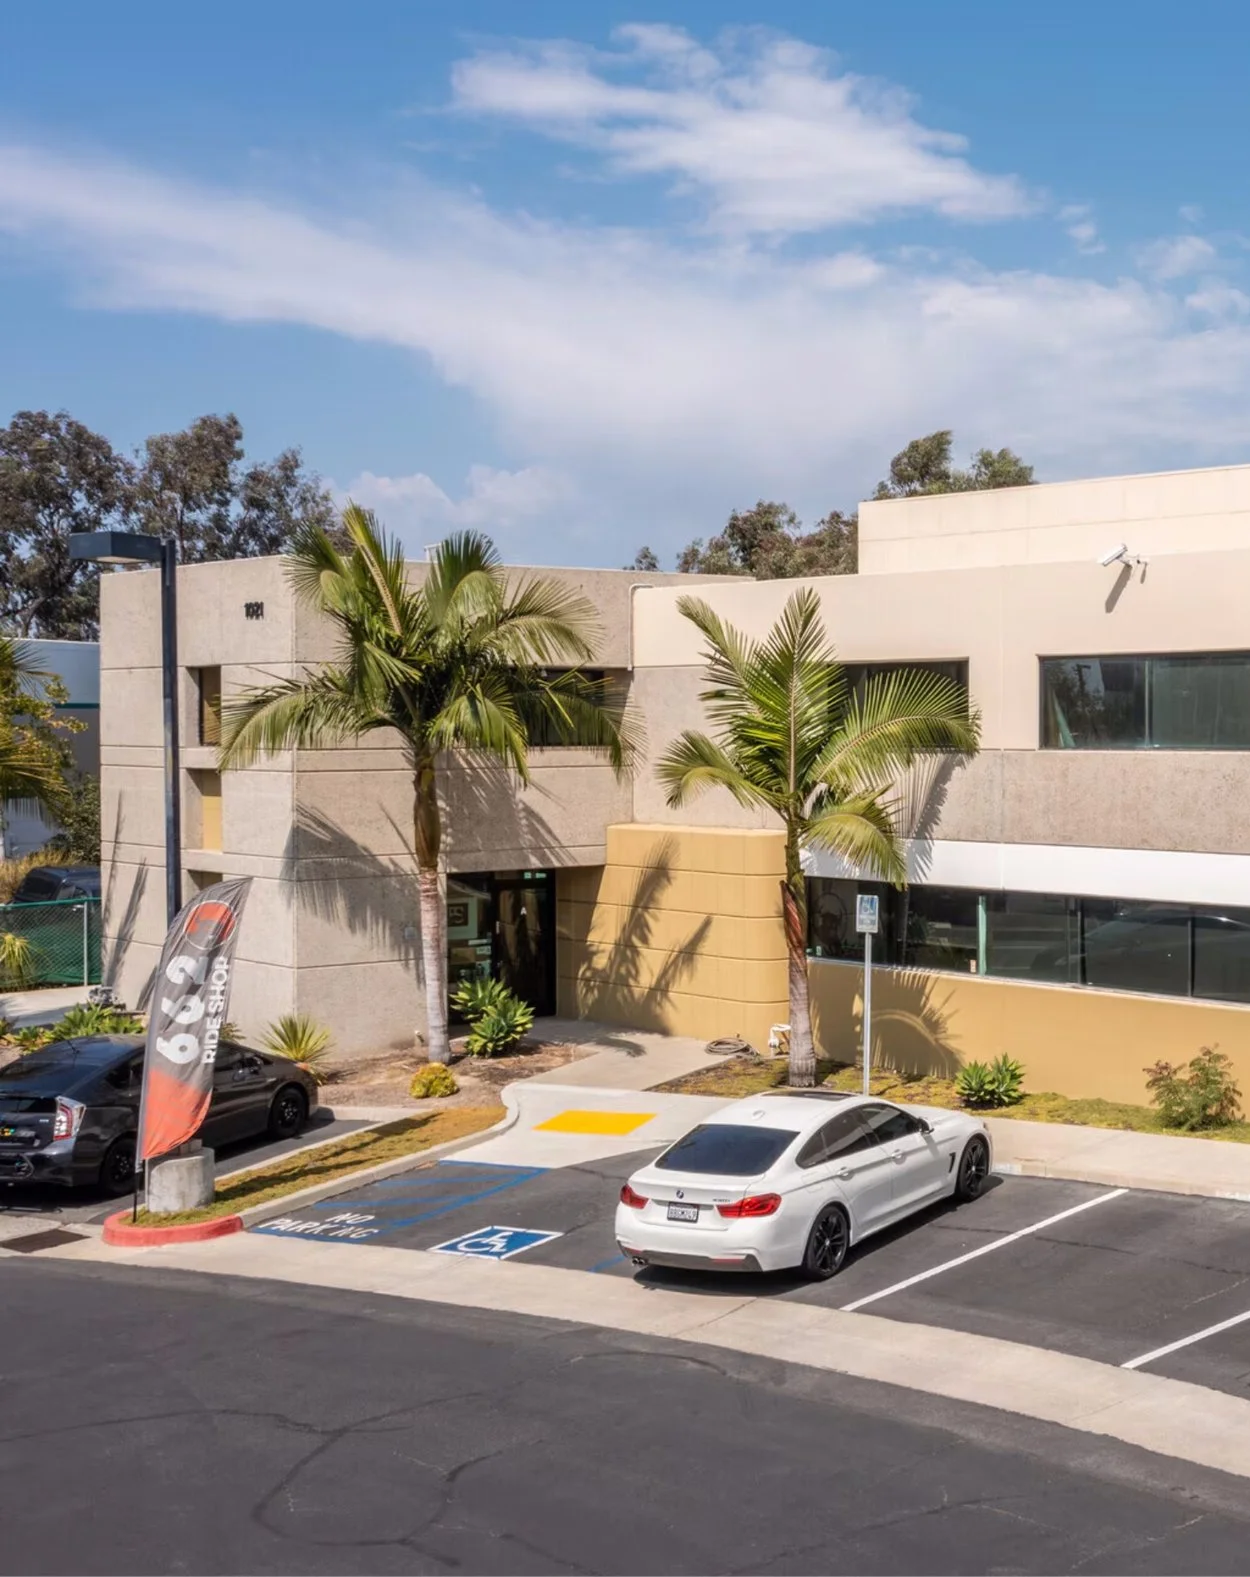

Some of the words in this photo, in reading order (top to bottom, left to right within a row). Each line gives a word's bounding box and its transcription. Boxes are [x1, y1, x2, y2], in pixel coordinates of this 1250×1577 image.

[156, 955, 209, 1065] 662
[210, 956, 231, 1013] SHOP
[203, 1017, 222, 1064] RIDE
[324, 1212, 376, 1225] NO
